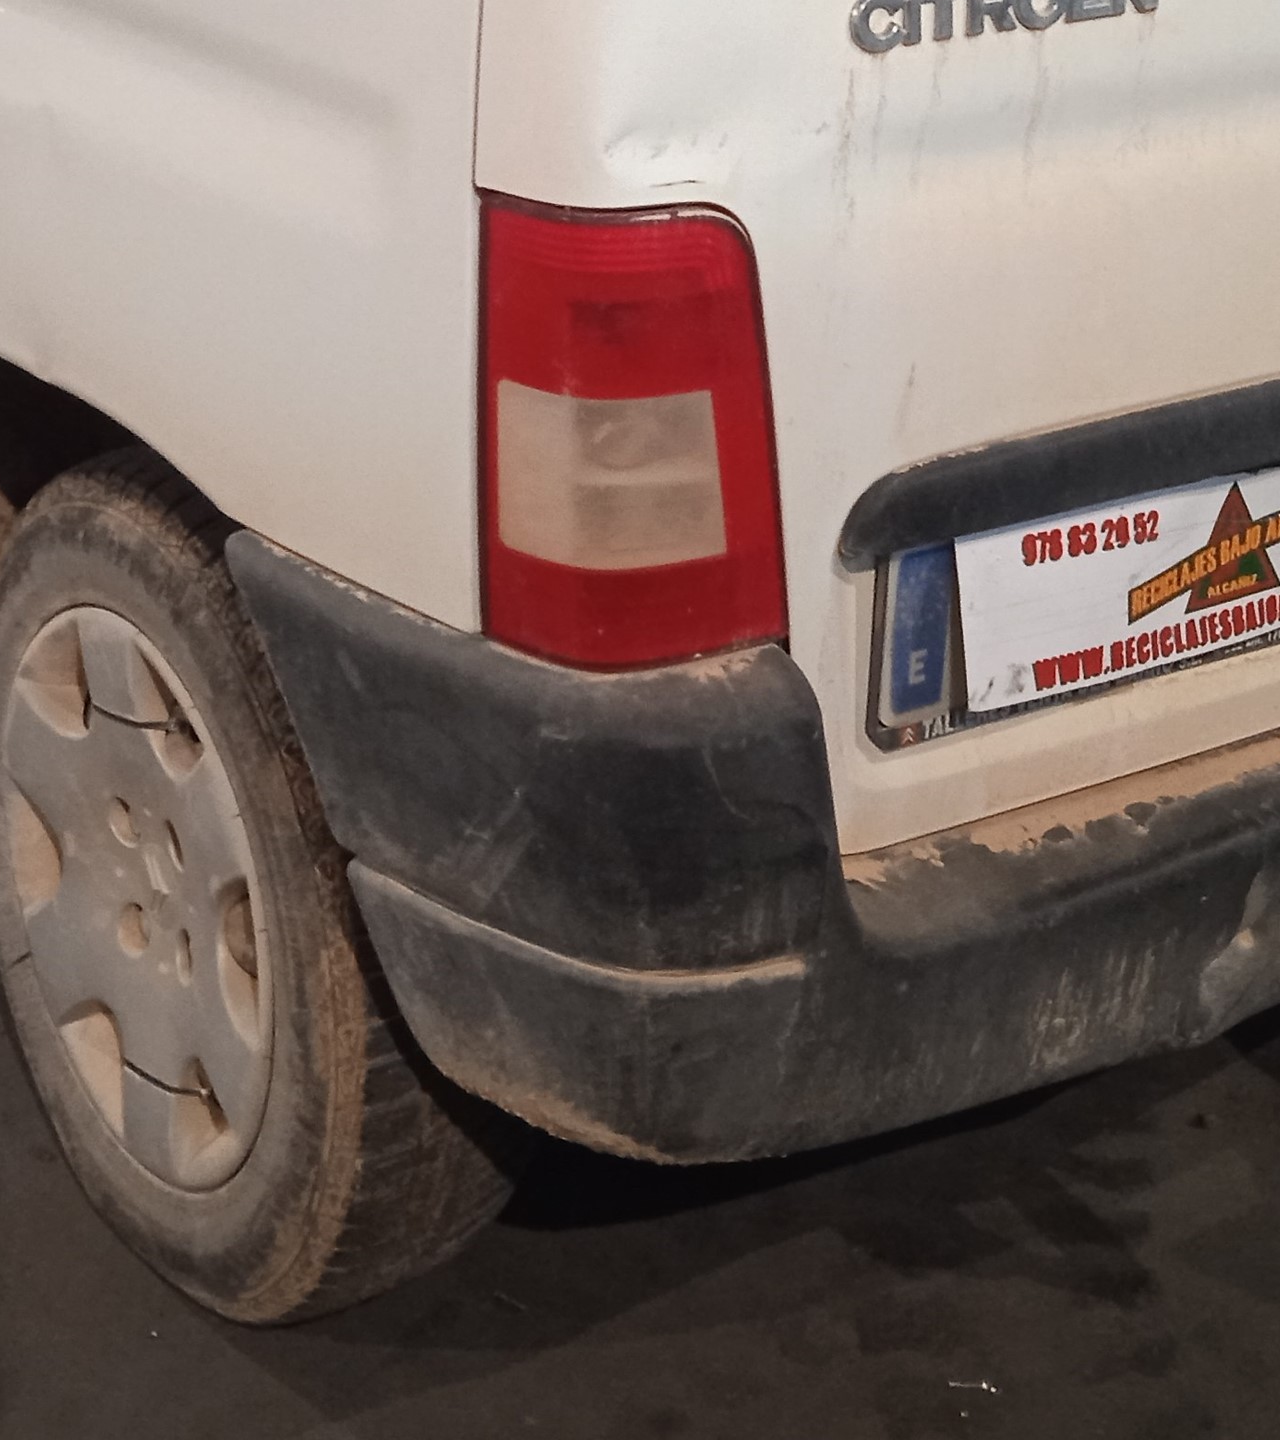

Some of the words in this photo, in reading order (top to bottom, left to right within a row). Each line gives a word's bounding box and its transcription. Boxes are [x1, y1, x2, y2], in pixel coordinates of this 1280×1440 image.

[1021, 528, 1063, 567] 978
[1133, 509, 1160, 545] 52
[1129, 545, 1218, 616] RECICLAJES
[1219, 523, 1263, 566] BAJO
[907, 648, 929, 686] E
